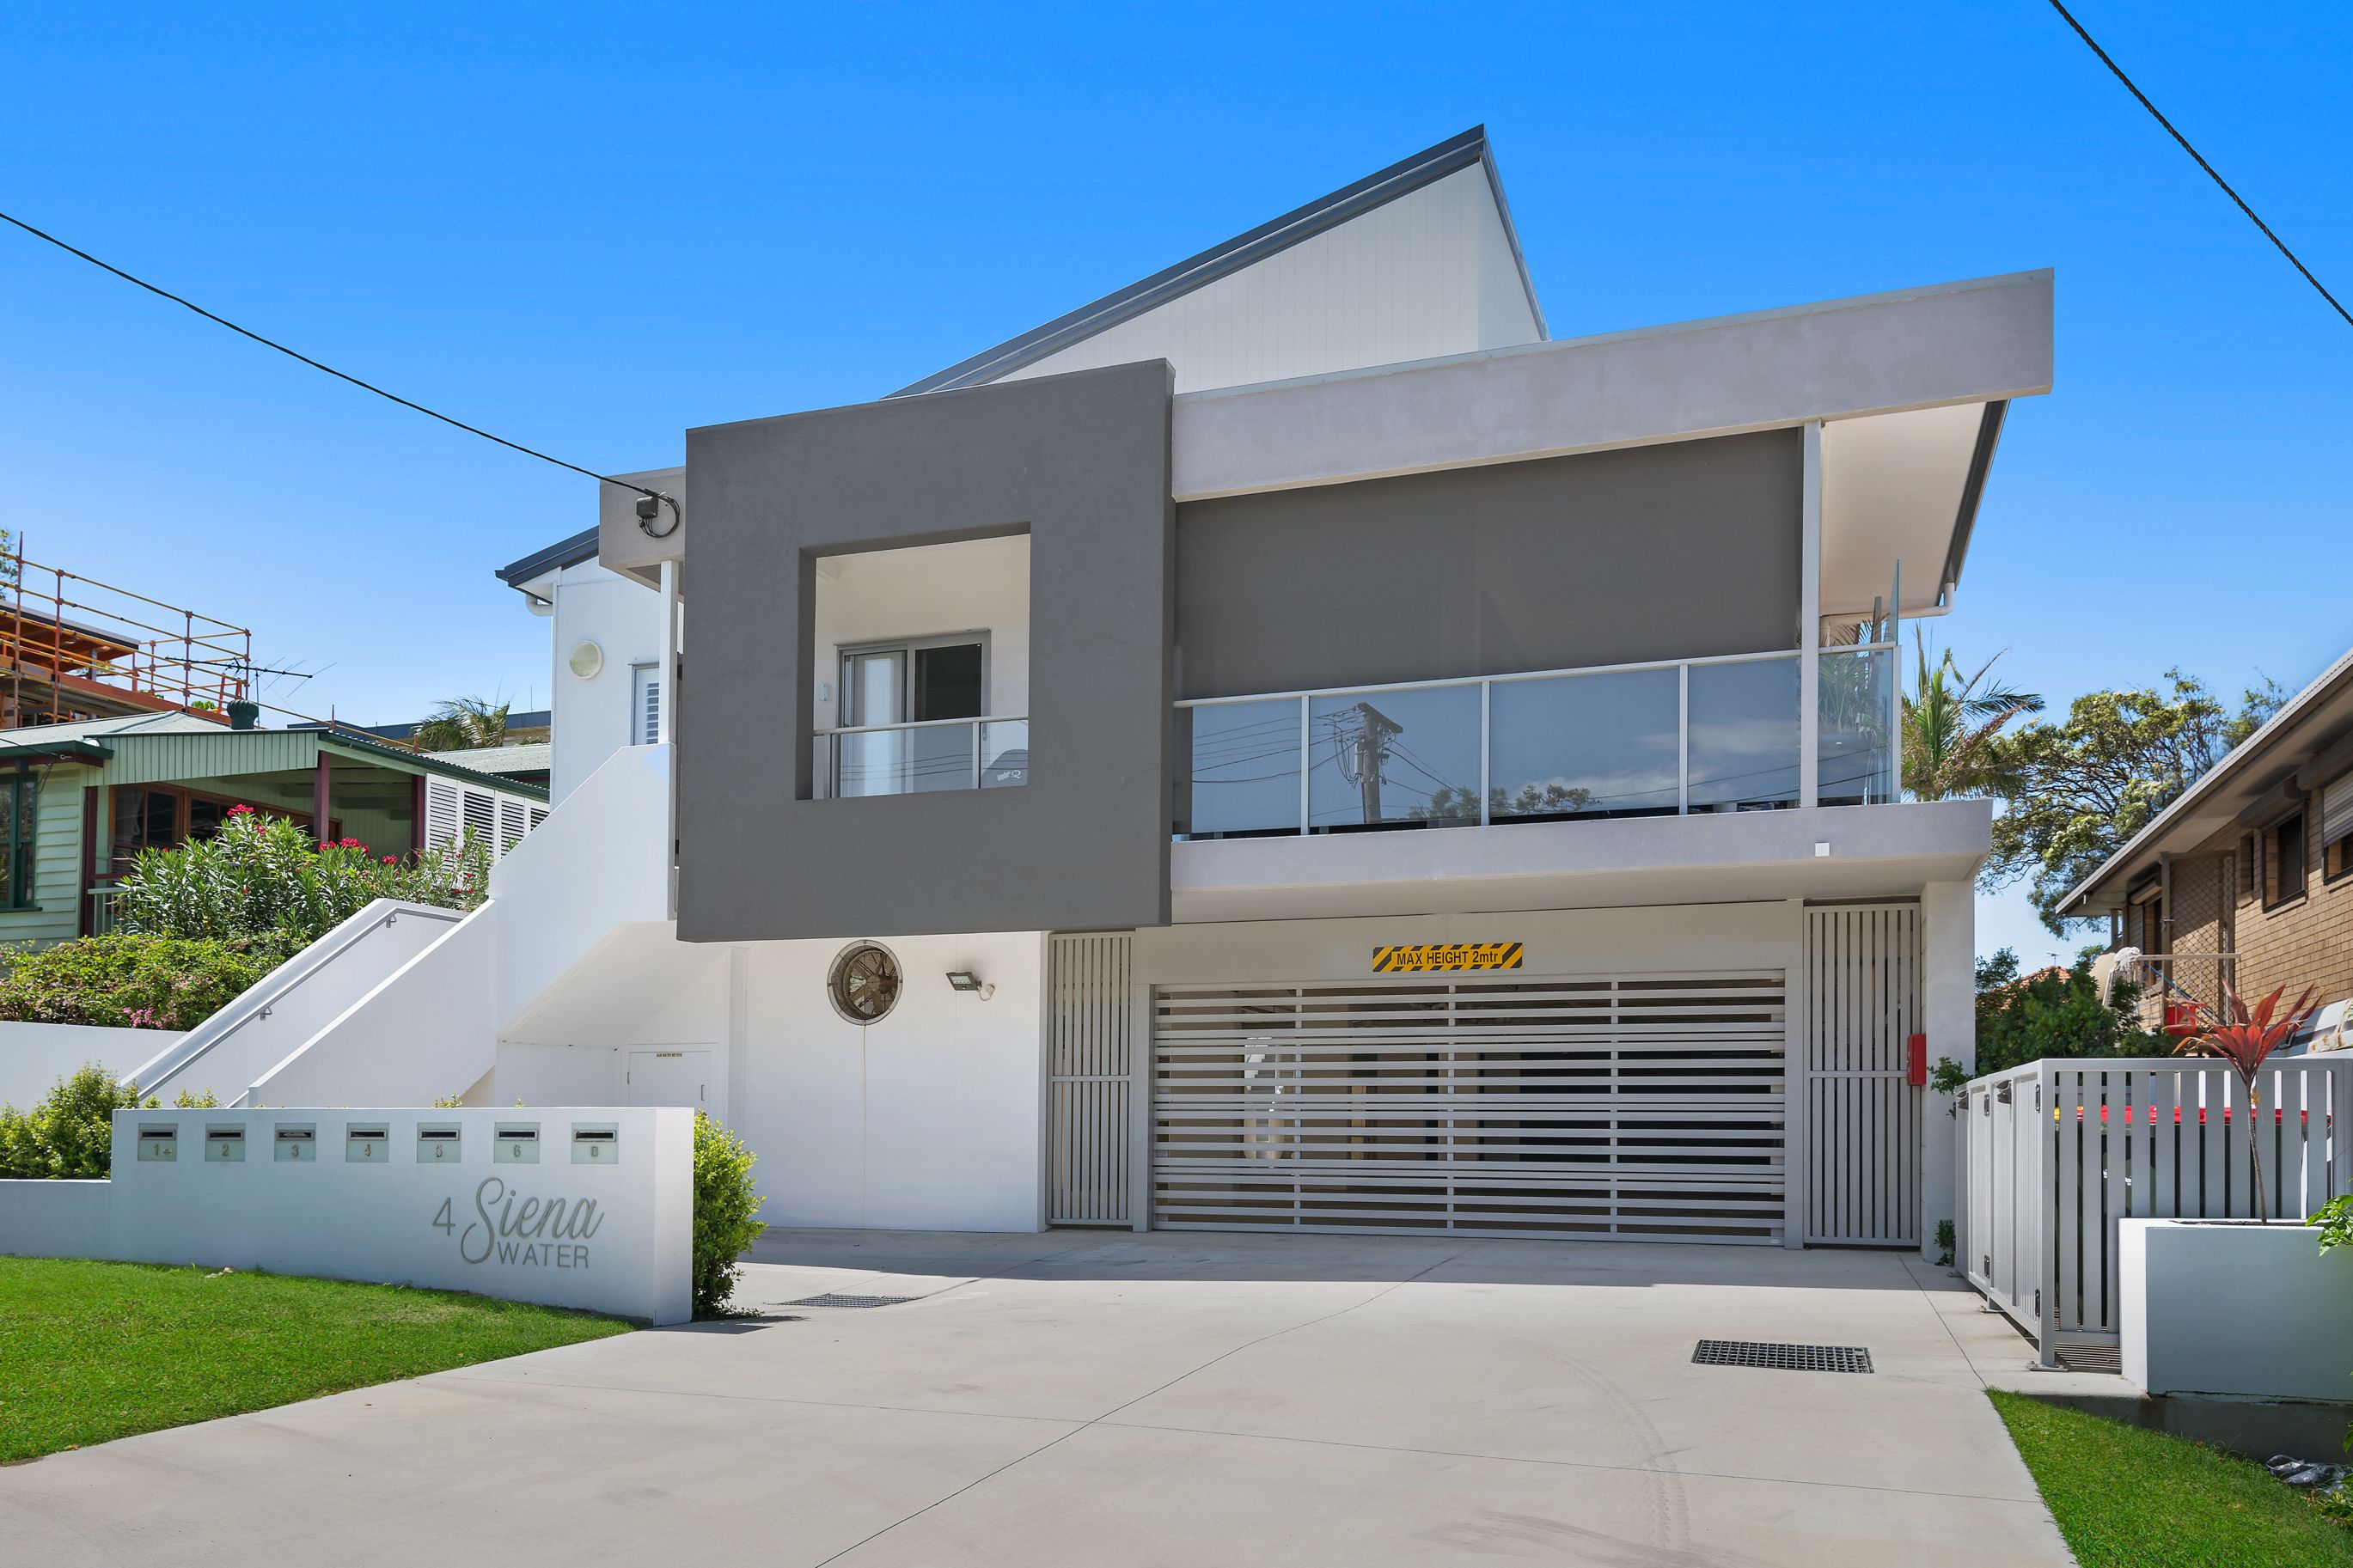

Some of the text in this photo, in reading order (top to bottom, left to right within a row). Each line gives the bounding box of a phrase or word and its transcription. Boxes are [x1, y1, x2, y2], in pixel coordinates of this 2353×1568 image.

[1397, 950, 1499, 965] MAX HEIGHT 2mtr
[154, 1144, 159, 1156] 1
[222, 1144, 229, 1156] 2
[291, 1144, 299, 1157] 3
[364, 1144, 371, 1156] 4
[436, 1144, 443, 1157] 5
[432, 1177, 605, 1264] 4 Siena
[498, 1242, 590, 1269] WATER
